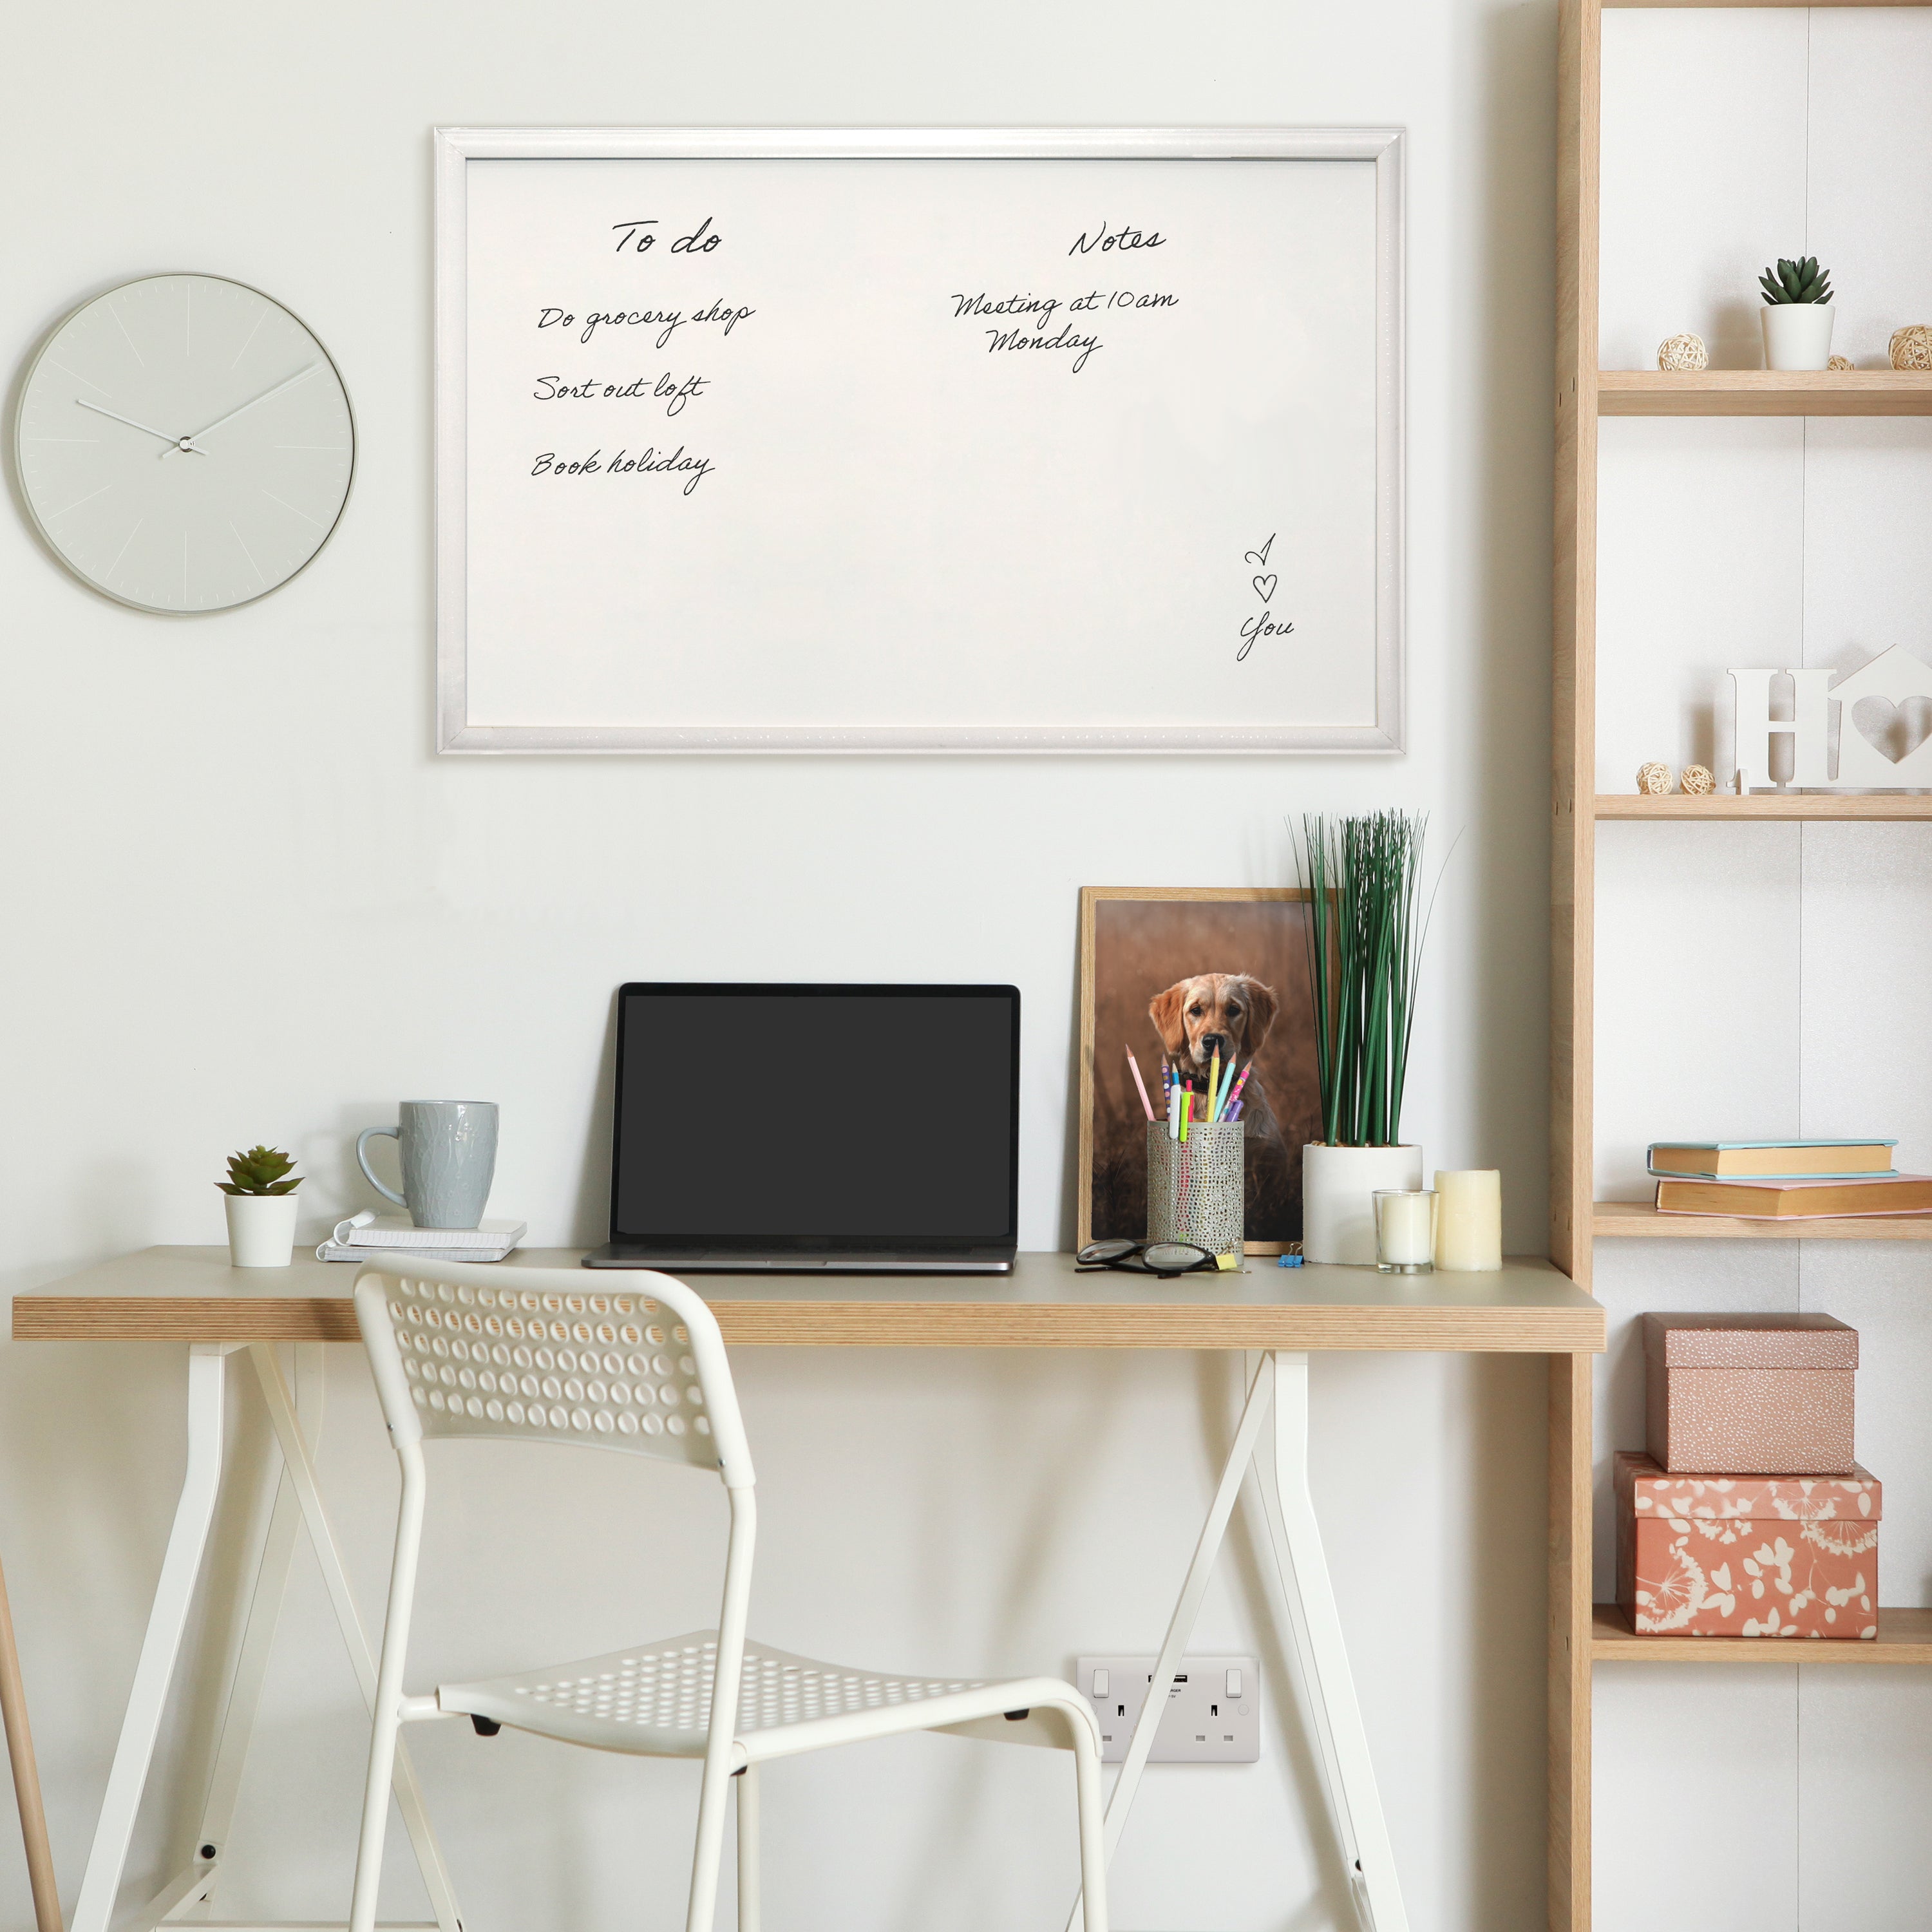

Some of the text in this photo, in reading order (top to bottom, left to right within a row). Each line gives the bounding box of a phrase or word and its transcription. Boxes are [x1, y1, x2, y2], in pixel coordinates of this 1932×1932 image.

[612, 216, 723, 254] To do
[1068, 220, 1167, 256] Notes
[538, 298, 756, 349] Do grocery shop
[951, 292, 1063, 330] Meeting
[1069, 290, 1106, 312] at
[985, 323, 1103, 374] Monday
[533, 372, 711, 417] Sort out loft
[531, 446, 715, 496] Book holiday
